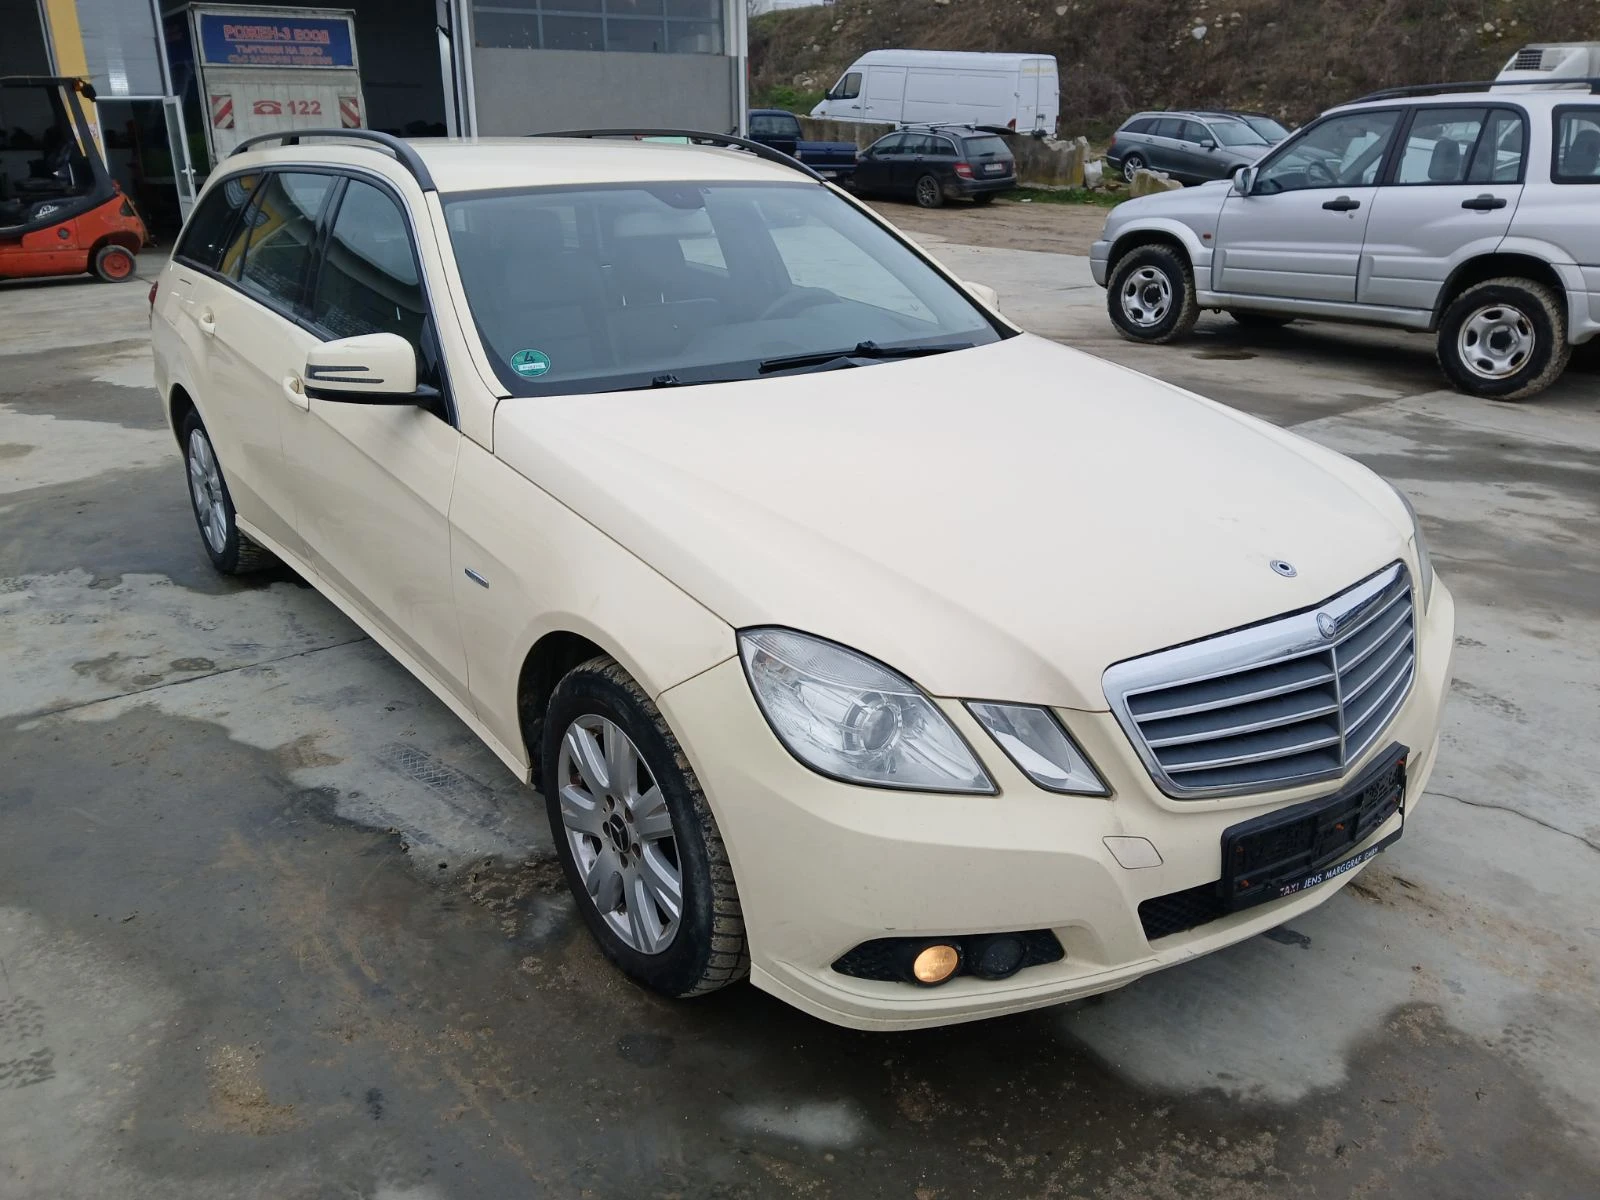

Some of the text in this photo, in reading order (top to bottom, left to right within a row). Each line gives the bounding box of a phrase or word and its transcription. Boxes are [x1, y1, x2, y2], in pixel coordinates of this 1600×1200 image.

[287, 100, 322, 116] 122
[524, 352, 535, 363] 4
[1303, 873, 1323, 888] JENS
[1325, 856, 1362, 879] MARGGRAF
